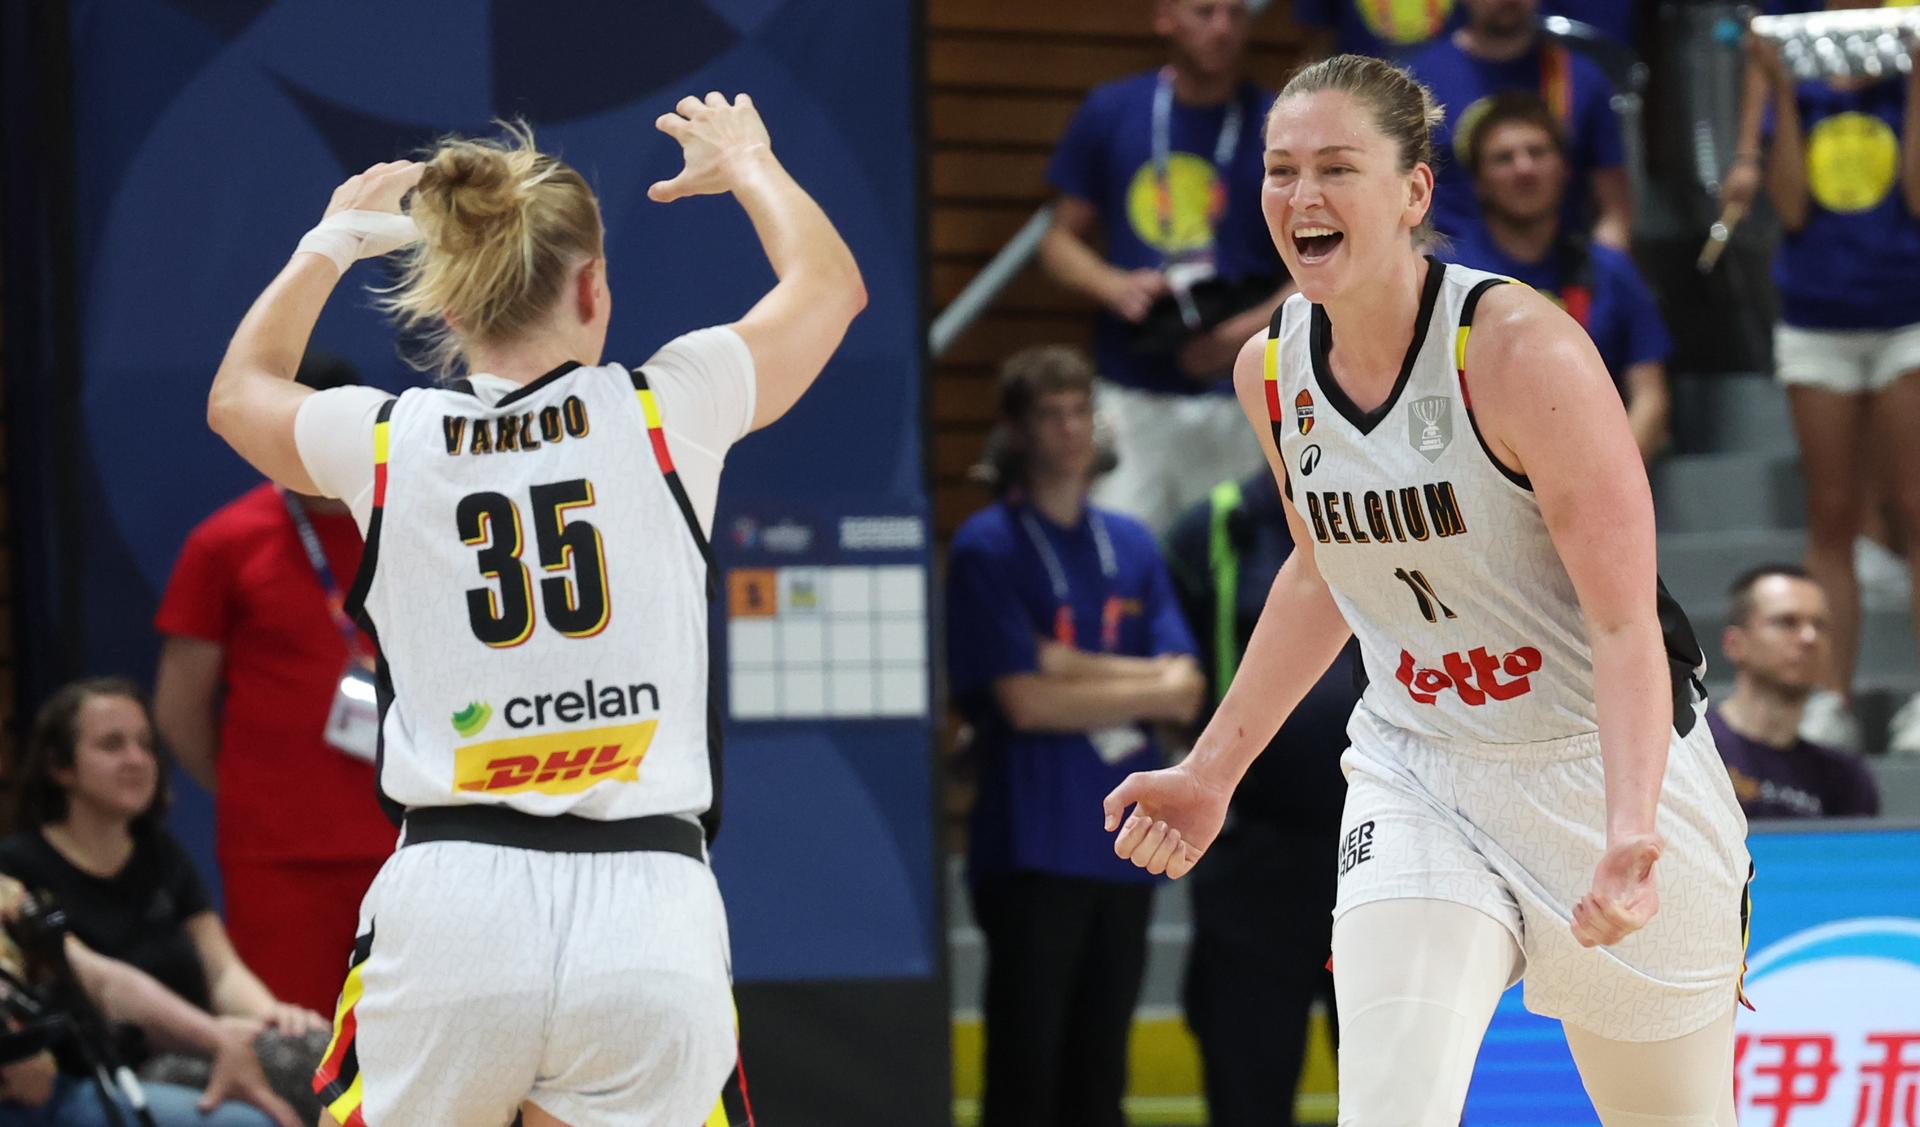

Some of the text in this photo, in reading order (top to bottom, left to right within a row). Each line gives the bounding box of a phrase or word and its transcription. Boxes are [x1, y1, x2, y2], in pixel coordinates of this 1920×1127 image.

[443, 395, 590, 456] VANLOO
[1306, 481, 1468, 544] BELGIUM
[456, 478, 611, 649] 35
[1394, 567, 1458, 624] 11
[504, 679, 660, 729] crelan
[486, 744, 630, 790] DHL
[1340, 820, 1375, 860] WER
